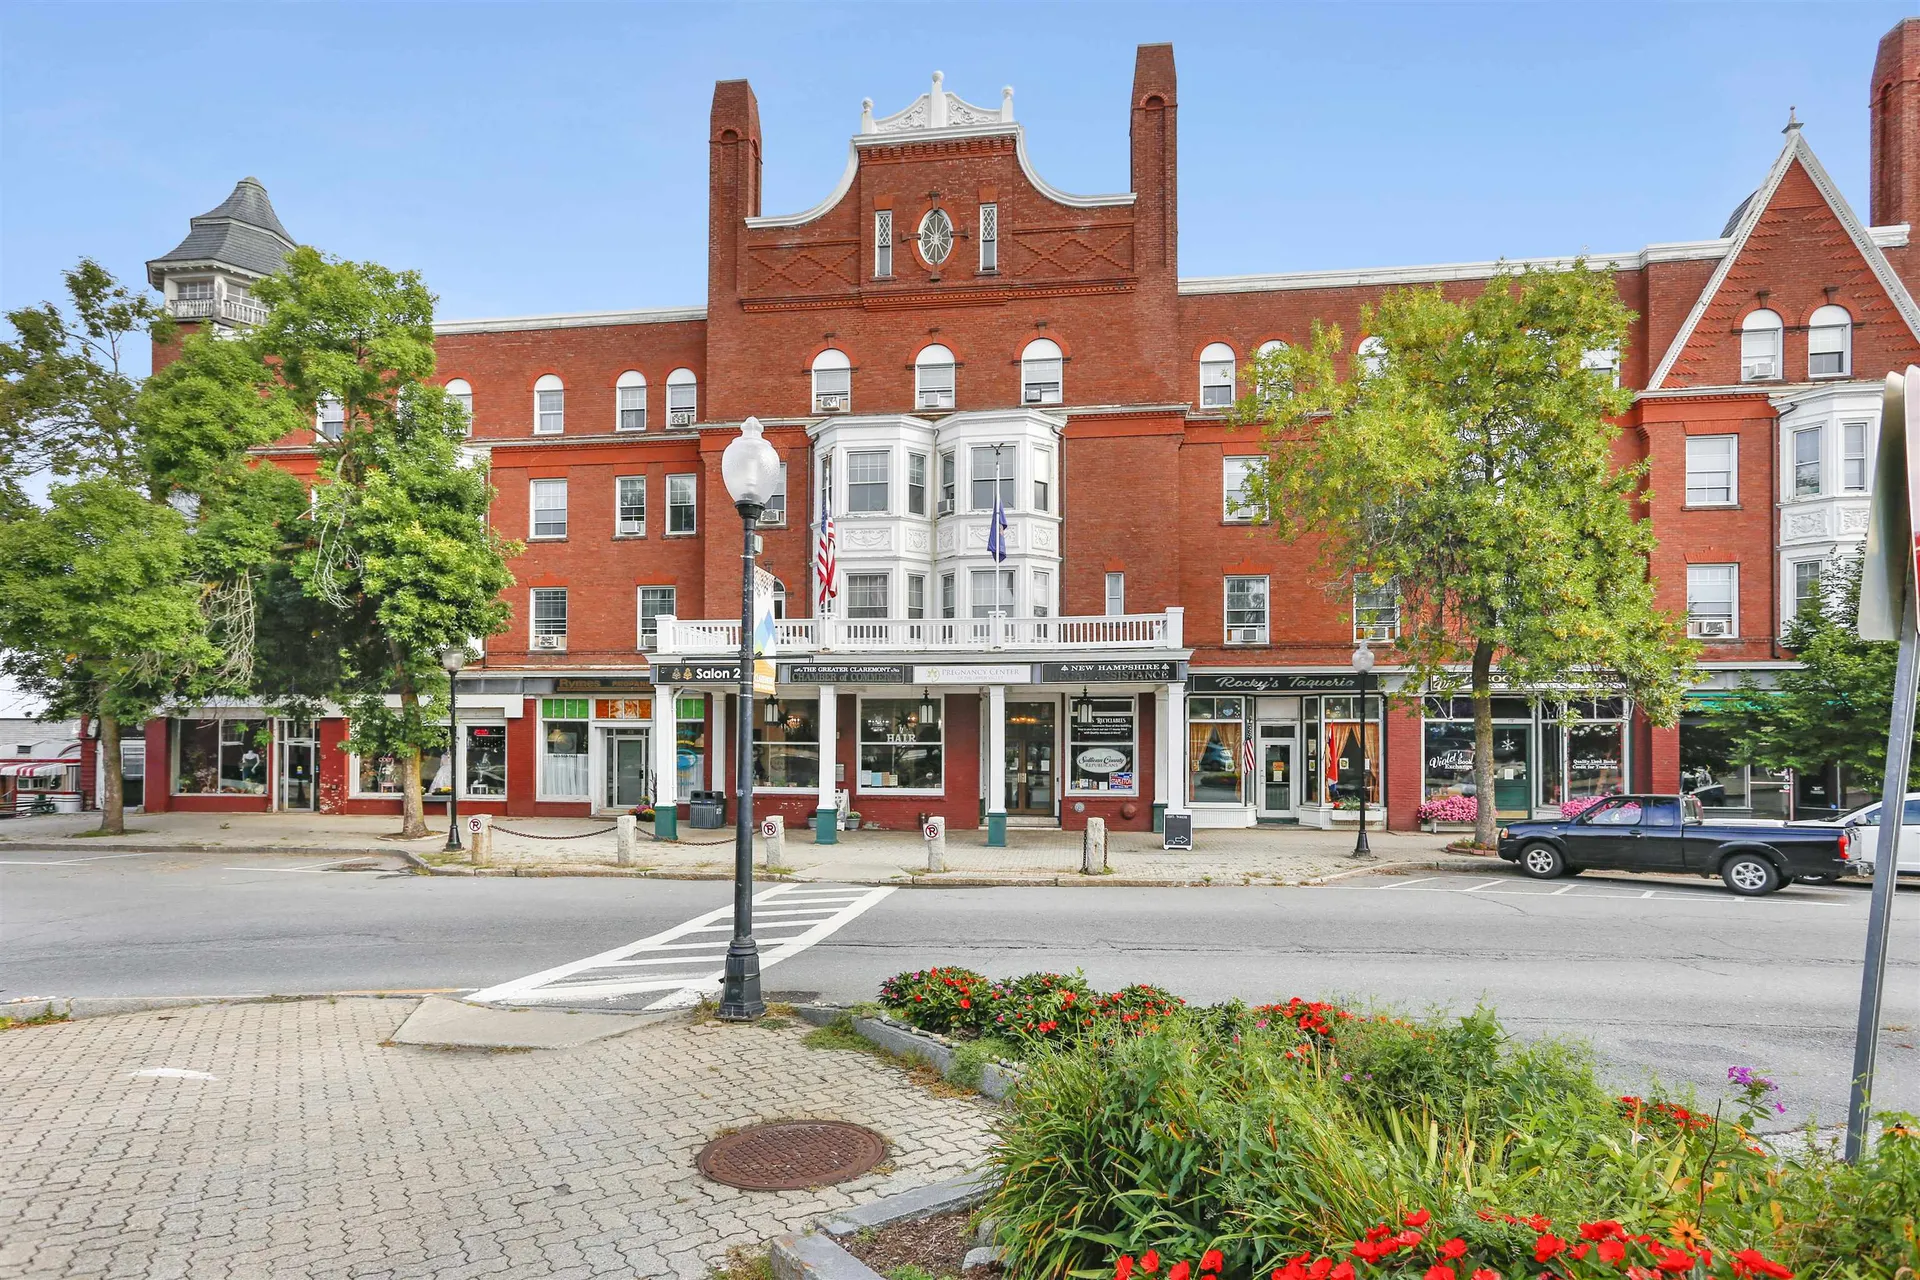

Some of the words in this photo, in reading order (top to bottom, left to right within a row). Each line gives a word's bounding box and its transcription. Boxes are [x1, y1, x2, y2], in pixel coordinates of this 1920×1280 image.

[696, 668, 730, 679] Salon
[942, 668, 987, 676] PREGNANCY
[989, 668, 1020, 676] CENTER
[792, 673, 837, 682] CHAMBER
[839, 673, 848, 682] of
[850, 673, 902, 682] COMMERCE
[560, 679, 600, 688] Rymes
[1215, 676, 1279, 691] Rocky's
[1288, 676, 1355, 688] Taqueria
[886, 734, 916, 742] HAIR
[1078, 756, 1102, 764] Sullivan
[1103, 756, 1125, 764] County
[1430, 750, 1463, 768] Violet's
